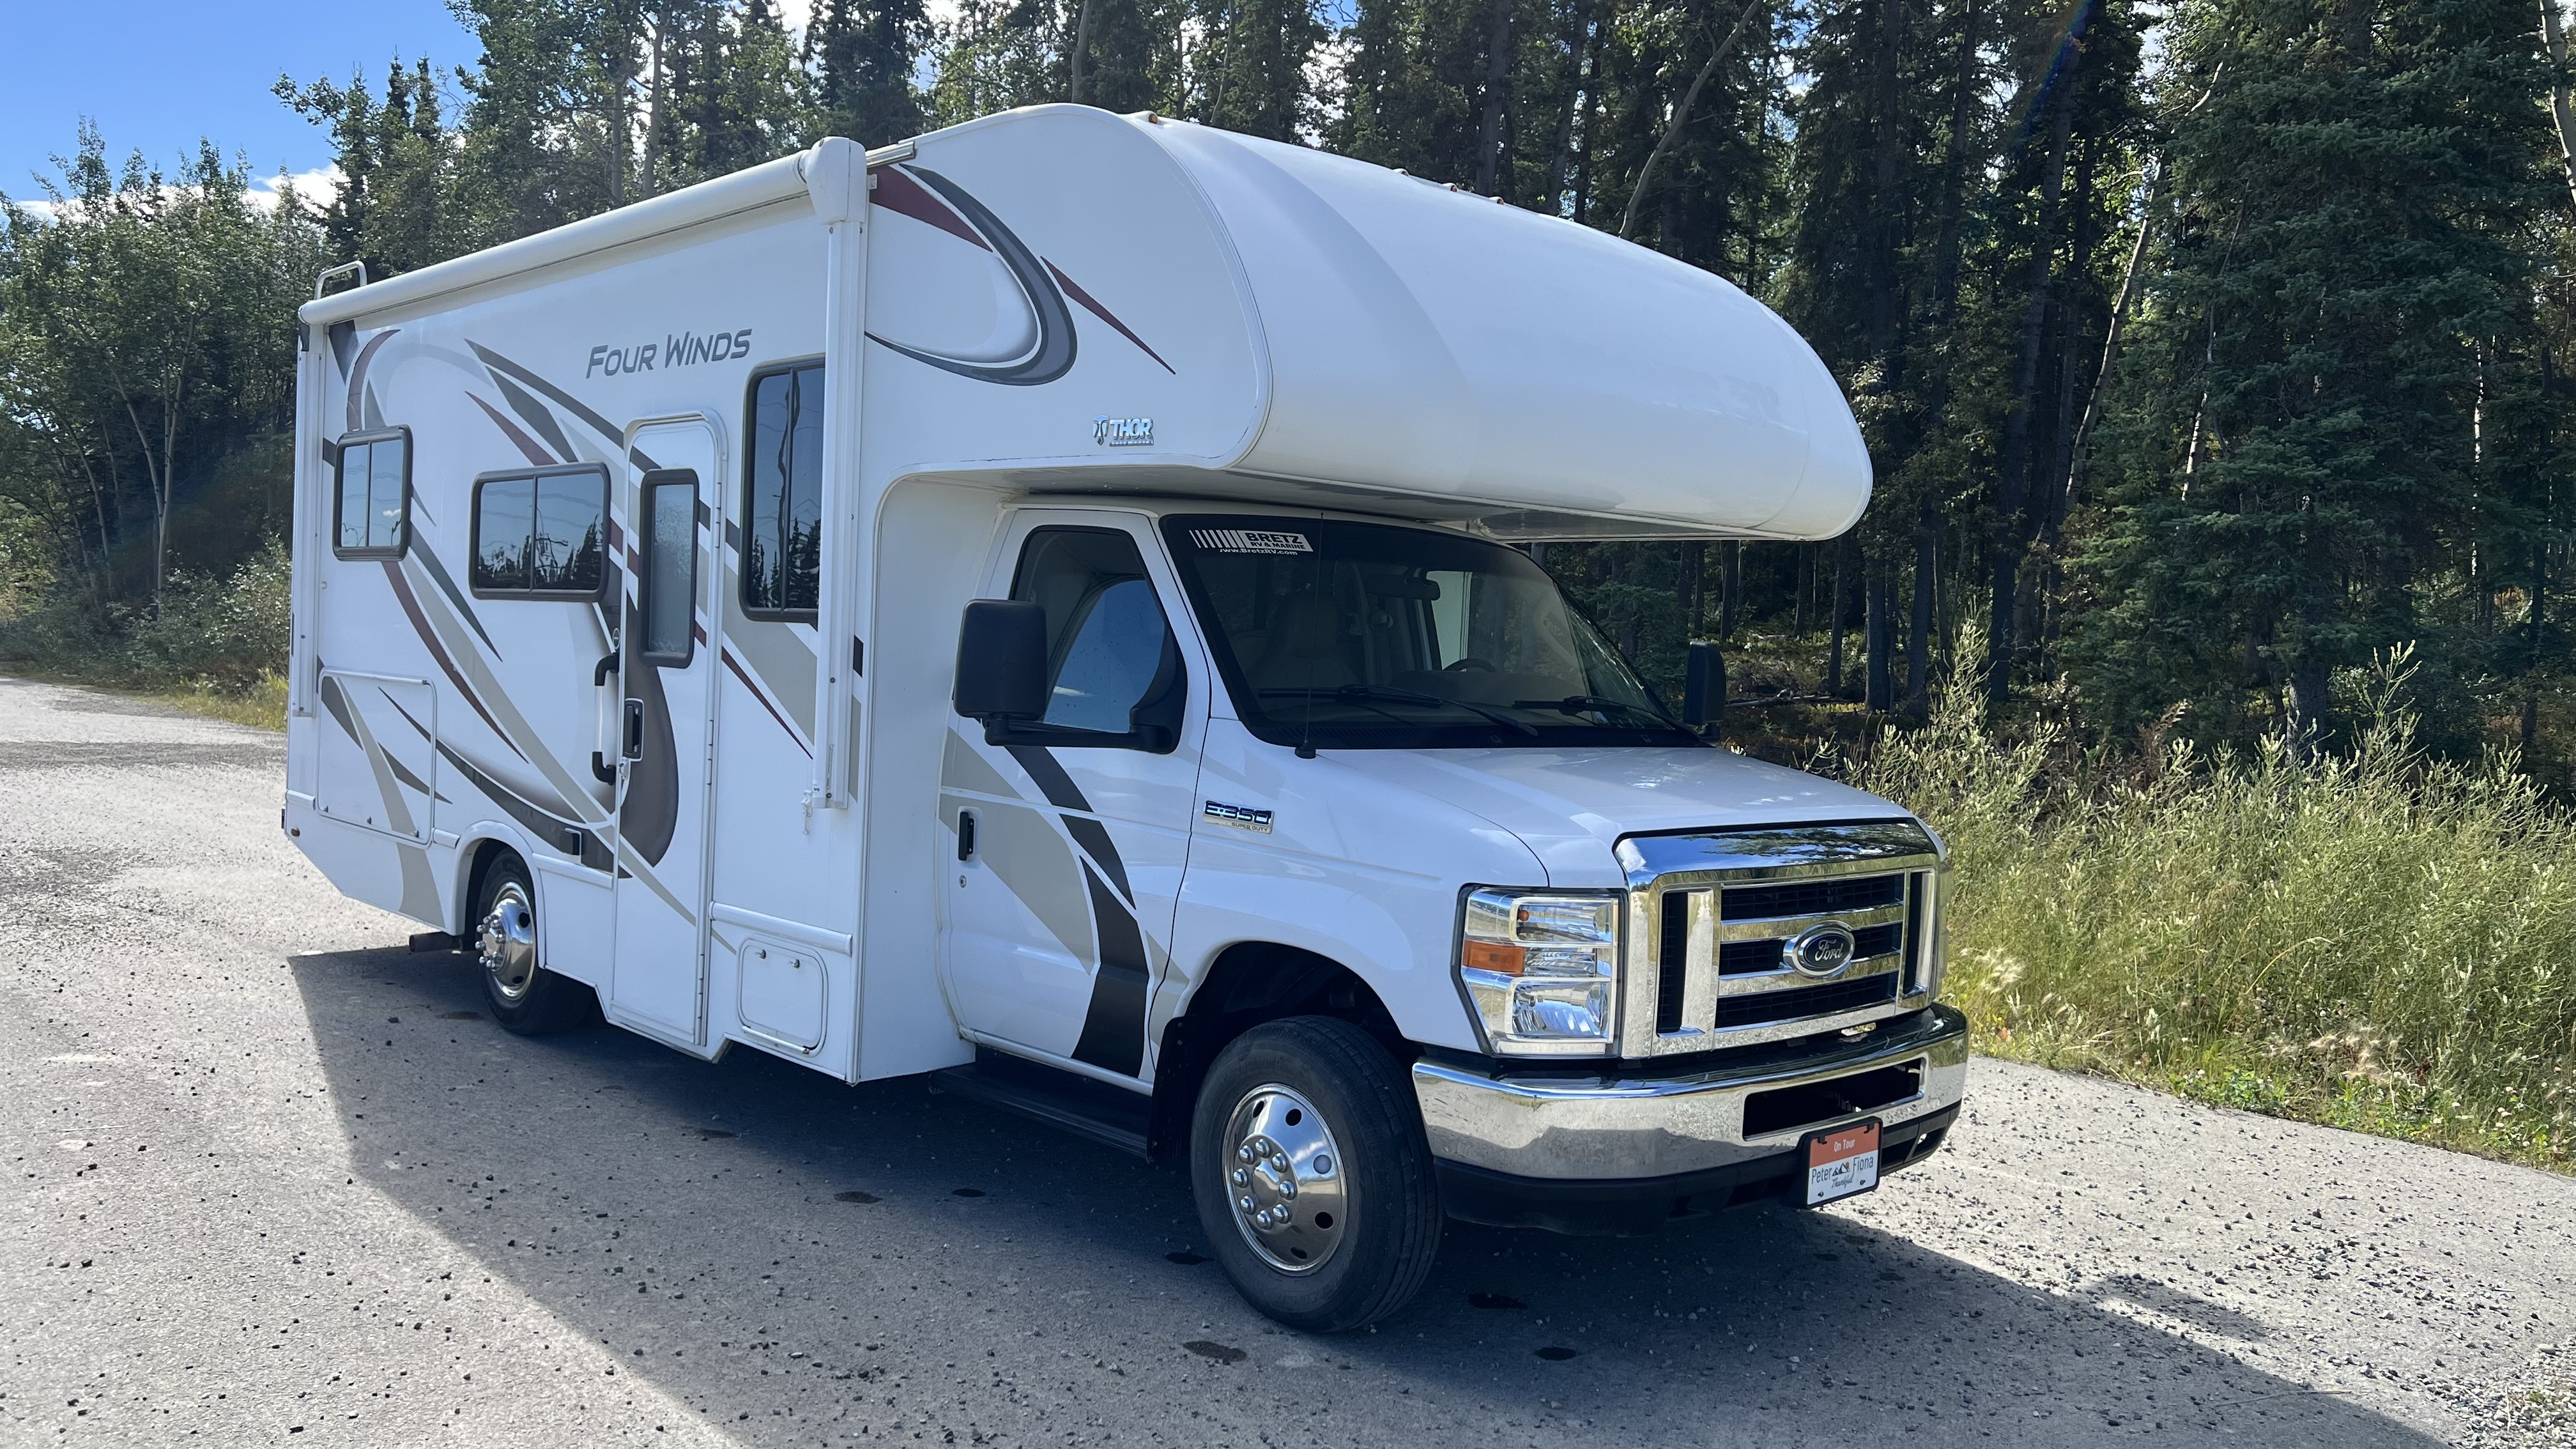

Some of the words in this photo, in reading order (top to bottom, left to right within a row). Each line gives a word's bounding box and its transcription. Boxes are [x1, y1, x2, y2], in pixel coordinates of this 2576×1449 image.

[585, 344, 657, 379] FOUR
[664, 328, 753, 369] WINDS
[1110, 418, 1154, 440] THOR
[1244, 532, 1303, 544] BRETZ
[1204, 800, 1272, 825] E-350
[1231, 822, 1251, 830] SUPER
[1814, 939, 1844, 962] Ford
[1834, 1141, 1841, 1152] On
[1843, 1139, 1855, 1149] Tour
[1811, 1167, 1833, 1184] Peter
[1852, 1156, 1873, 1174] Fiona
